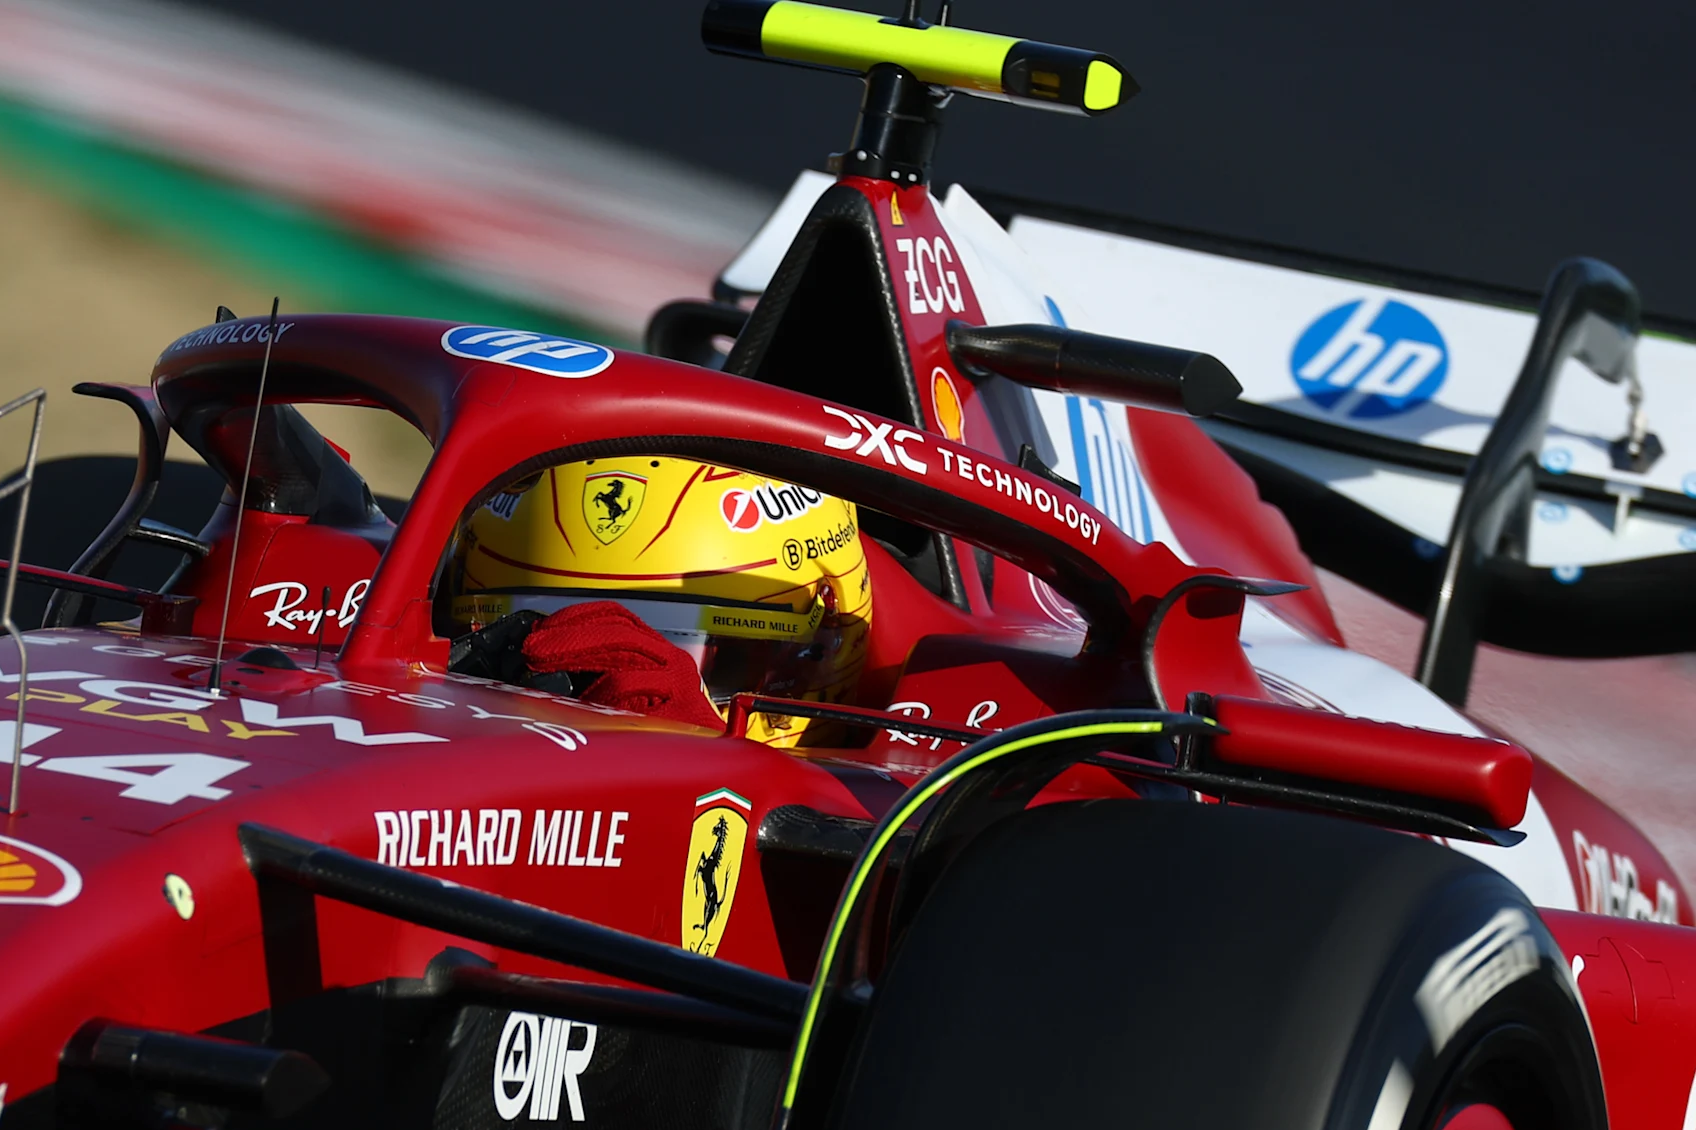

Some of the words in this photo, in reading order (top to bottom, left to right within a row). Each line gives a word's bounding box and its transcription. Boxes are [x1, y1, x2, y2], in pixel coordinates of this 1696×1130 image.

[450, 327, 607, 370] hp
[1294, 299, 1446, 418] hp
[937, 446, 1101, 545] TECHNOLOGY
[249, 579, 372, 635] Ray-B
[713, 615, 766, 630] RICHARD
[769, 620, 799, 634] MILLE
[6, 687, 300, 740] PLAY
[374, 808, 523, 867] RICHARD
[527, 810, 630, 867] MILLE
